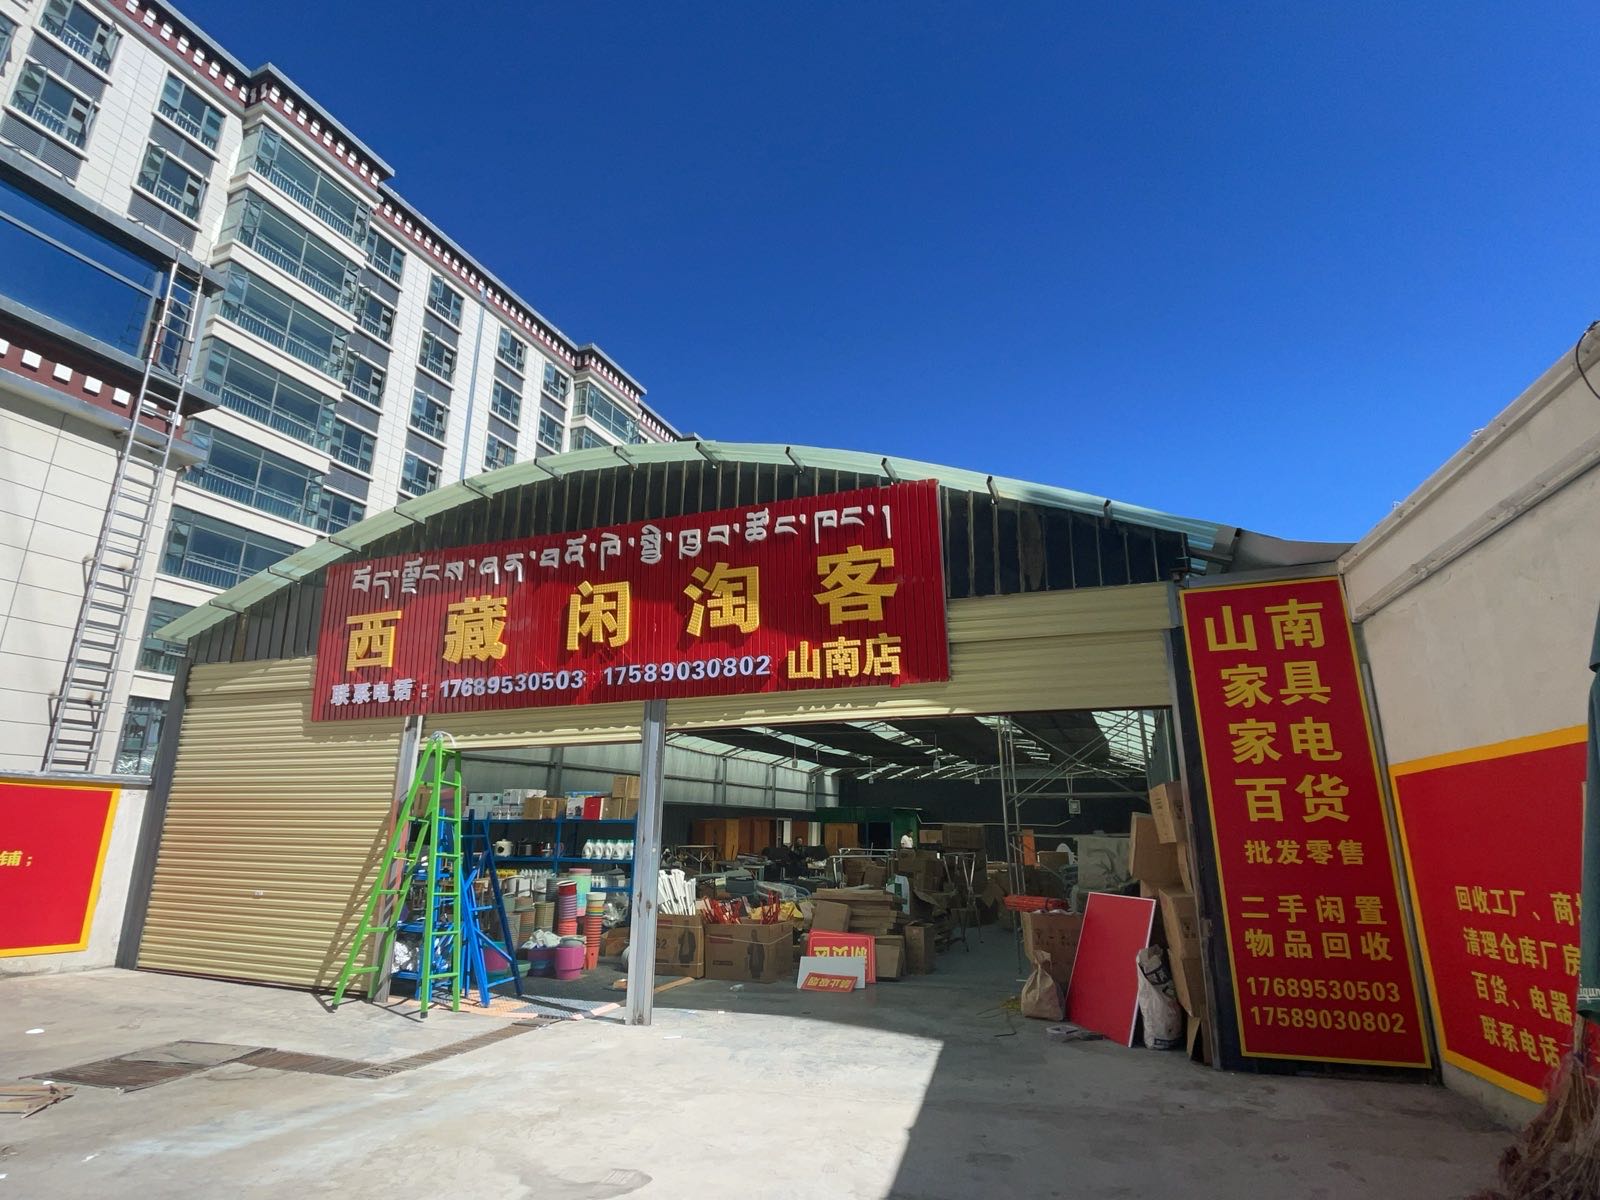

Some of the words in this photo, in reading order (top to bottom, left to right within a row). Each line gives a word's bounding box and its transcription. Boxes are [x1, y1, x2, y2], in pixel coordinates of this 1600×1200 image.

[345, 545, 898, 672] 西藏闲淘客
[1204, 599, 1325, 651] 山南
[440, 670, 584, 698] 17689530503
[603, 654, 771, 688] 17589030802
[787, 635, 903, 680] 山南店
[1221, 661, 1331, 708] 家具
[1229, 717, 1342, 765] 家电
[1235, 774, 1350, 823] 百货
[1244, 840, 1364, 865] 批发零售
[1241, 895, 1387, 925] 二手闲置
[1245, 928, 1393, 961] 物品回收
[1247, 976, 1400, 1002] 17689530503
[1251, 1006, 1406, 1034] 17589030802
